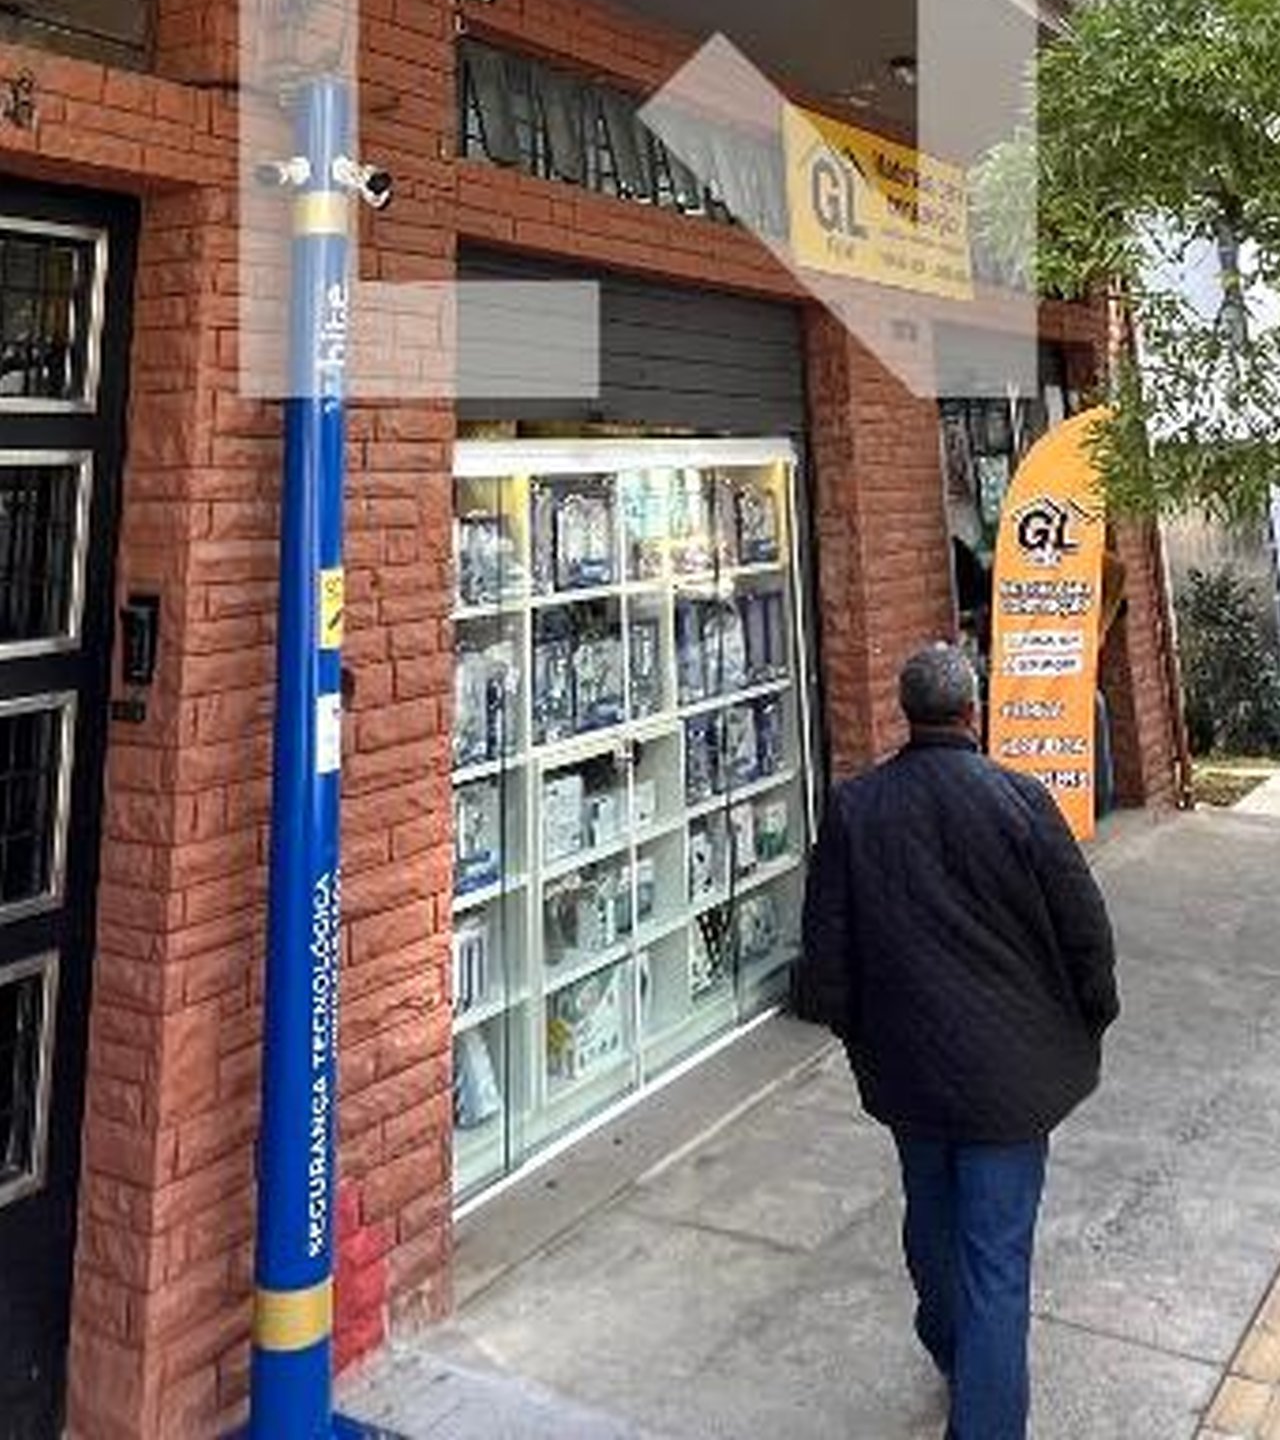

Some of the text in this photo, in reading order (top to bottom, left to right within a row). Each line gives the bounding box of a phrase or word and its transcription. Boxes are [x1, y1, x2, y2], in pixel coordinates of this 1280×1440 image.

[812, 155, 870, 240] GL
[1017, 510, 1080, 550] GL
[308, 870, 331, 1258] SEGURANÇA TECNOLÓGICA
